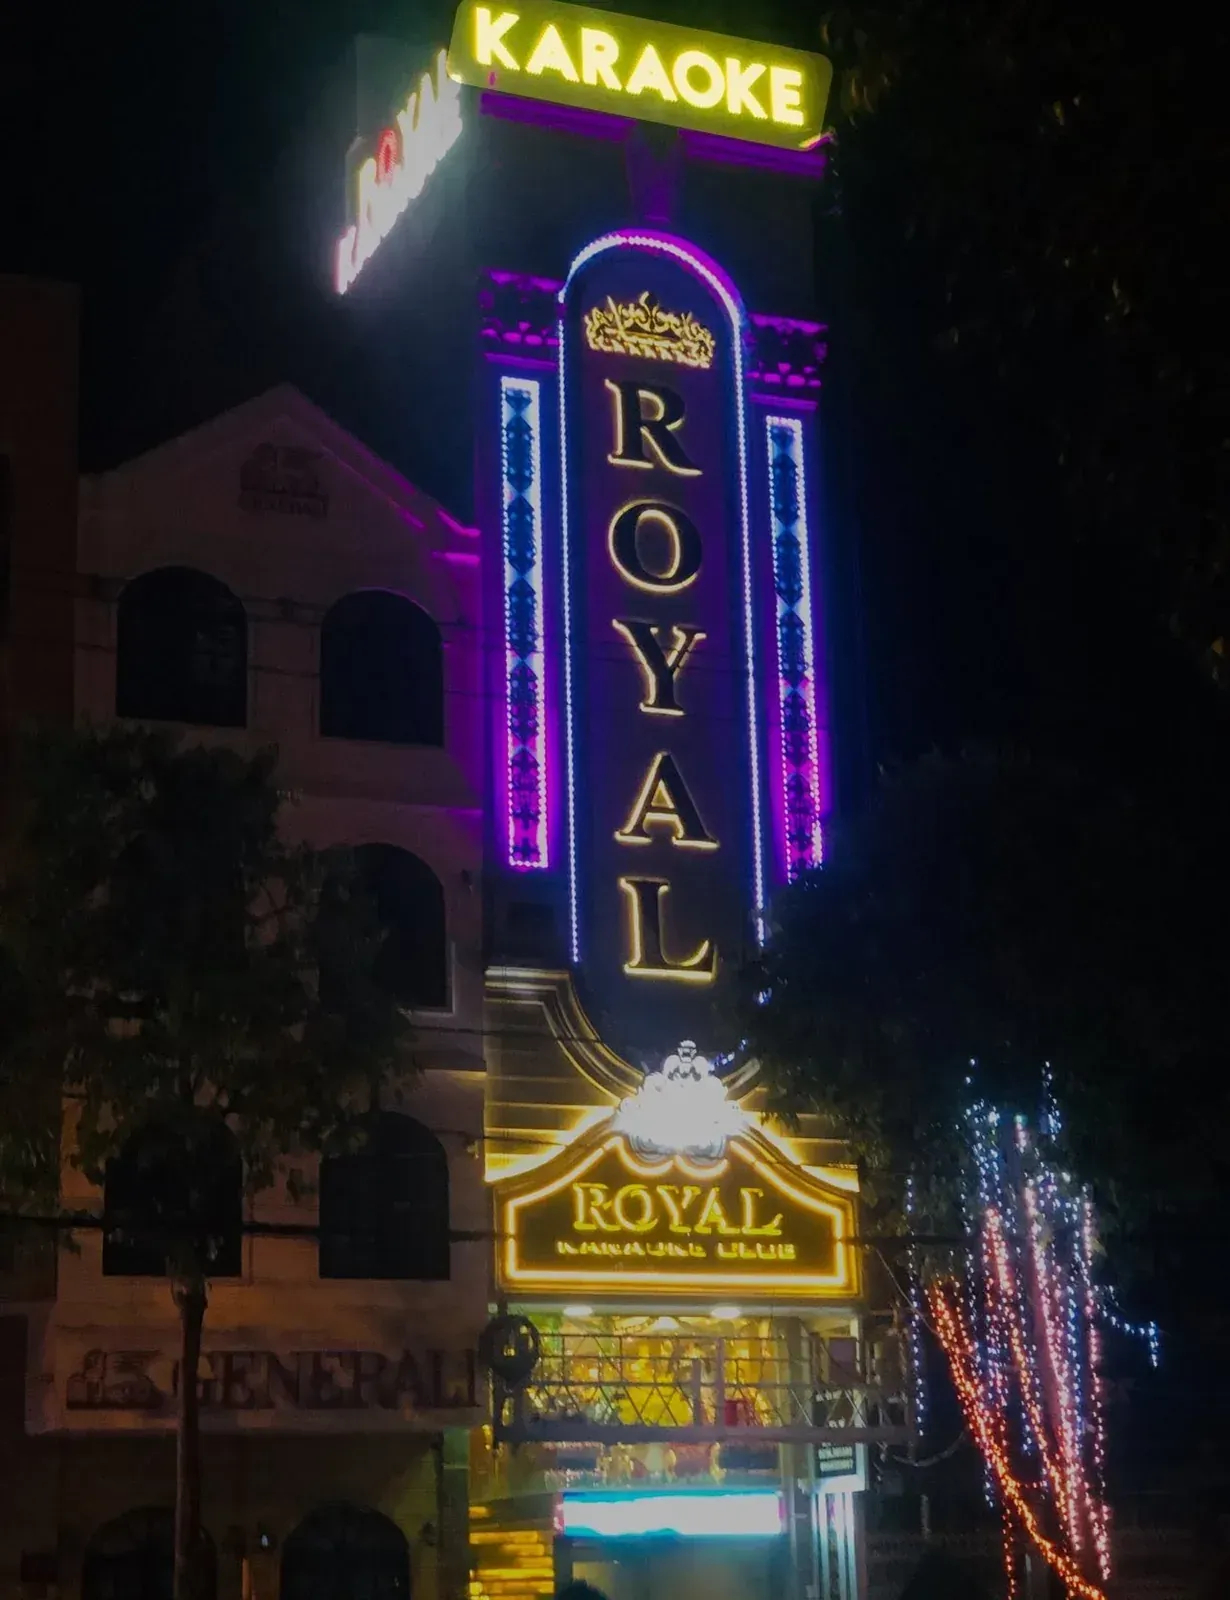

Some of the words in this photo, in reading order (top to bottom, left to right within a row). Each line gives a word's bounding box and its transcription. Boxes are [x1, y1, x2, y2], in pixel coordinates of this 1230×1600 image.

[474, 7, 806, 127] KARAOKE
[604, 377, 719, 984] ROYAL
[572, 1182, 784, 1236] ROYAL
